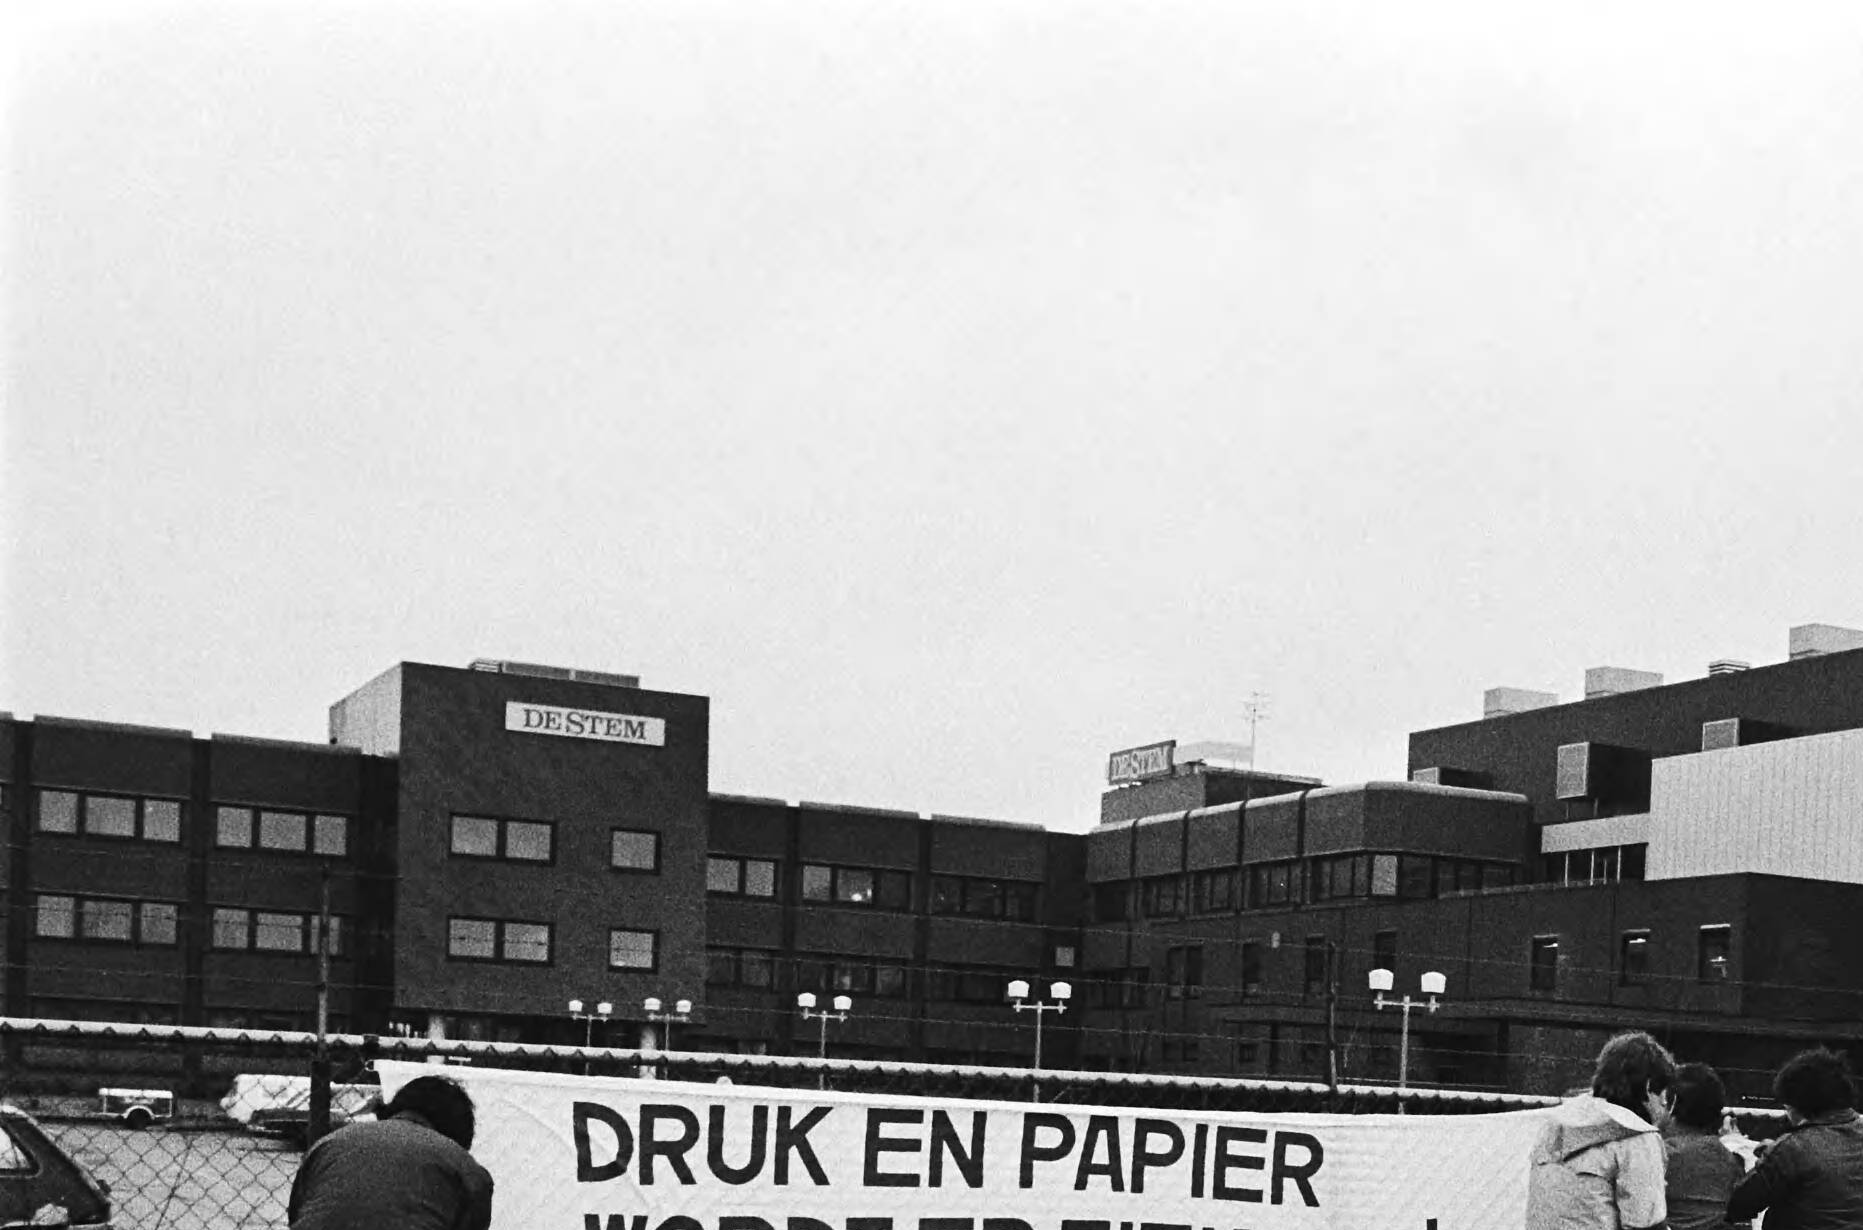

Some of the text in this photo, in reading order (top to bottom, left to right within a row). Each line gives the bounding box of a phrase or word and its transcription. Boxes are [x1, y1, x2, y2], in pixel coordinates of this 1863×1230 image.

[572, 1101, 1324, 1208] DRUK EN PAPIER
